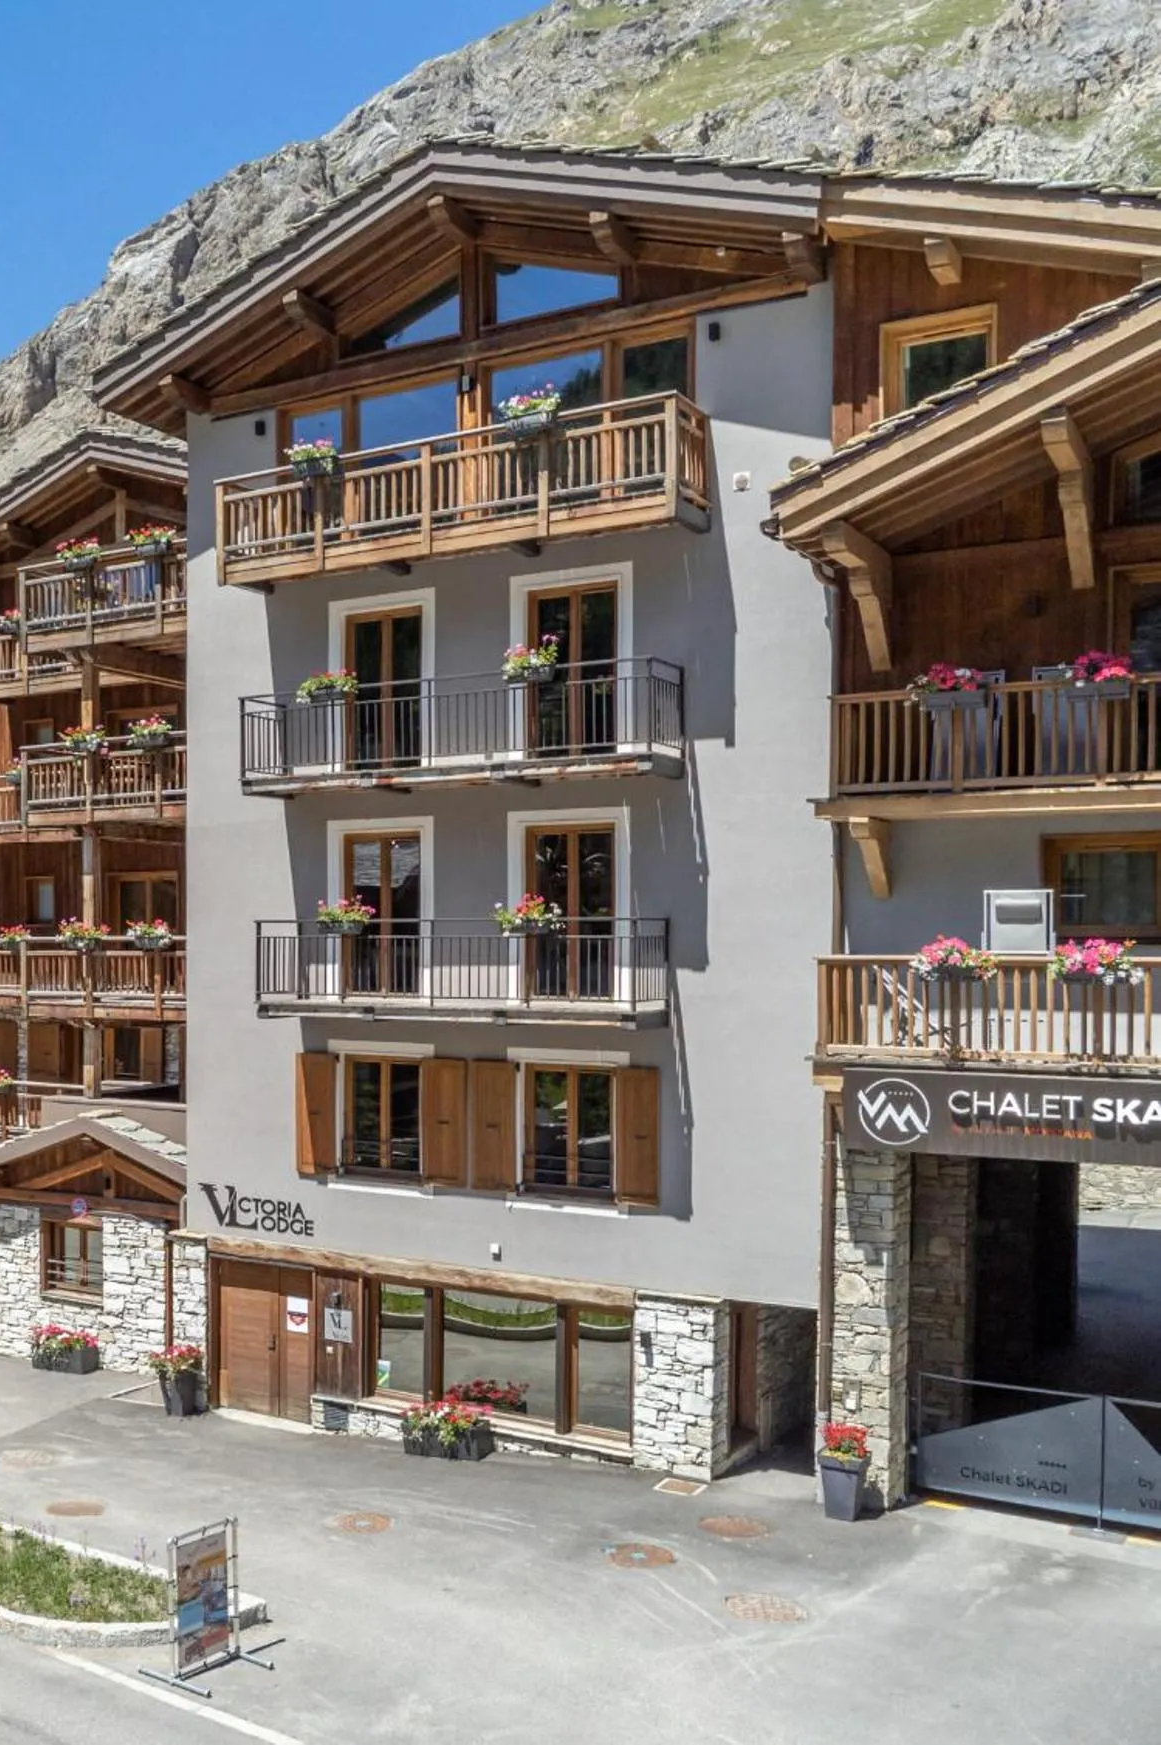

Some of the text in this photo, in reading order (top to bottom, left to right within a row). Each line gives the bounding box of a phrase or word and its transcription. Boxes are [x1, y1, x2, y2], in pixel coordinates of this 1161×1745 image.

[948, 1090, 1161, 1125] CHALET SKA
[960, 1466, 1068, 1495] Chalet SKADI
